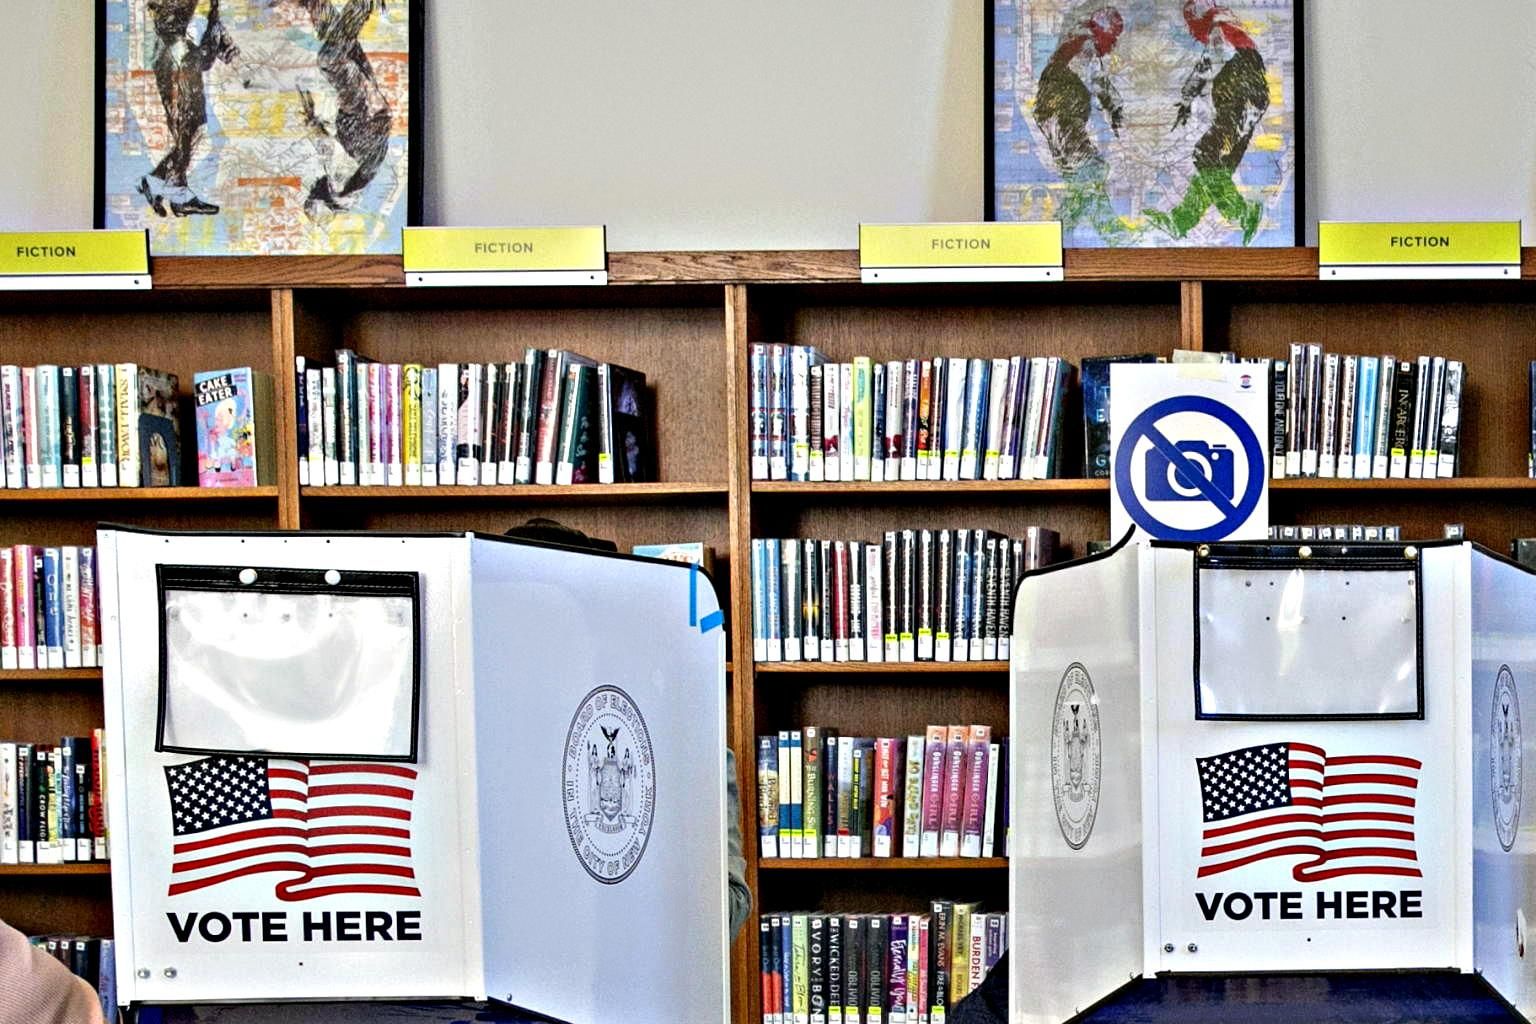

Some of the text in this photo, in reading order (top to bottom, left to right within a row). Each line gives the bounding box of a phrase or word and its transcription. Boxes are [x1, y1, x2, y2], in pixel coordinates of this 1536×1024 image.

[16, 246, 76, 258] FICTION
[474, 242, 533, 254] FICTION
[931, 238, 991, 250] FICTION
[1390, 236, 1449, 248] FICTION
[198, 387, 233, 406] EATER
[199, 375, 228, 393] CAKE
[1273, 381, 1284, 455] YOUR ONE AND ONLY
[1395, 389, 1411, 449] INCARCER
[1197, 891, 1422, 920] VOTE HERE
[167, 911, 422, 942] VOTE HERE
[829, 934, 840, 1006] WICKED DEE
[937, 943, 945, 967] EVANS
[972, 936, 981, 979] BURDEN
[810, 931, 822, 1014] VORY BON
[847, 970, 858, 1006] OBLIVIO
[870, 970, 881, 1006] OBLIVIO
